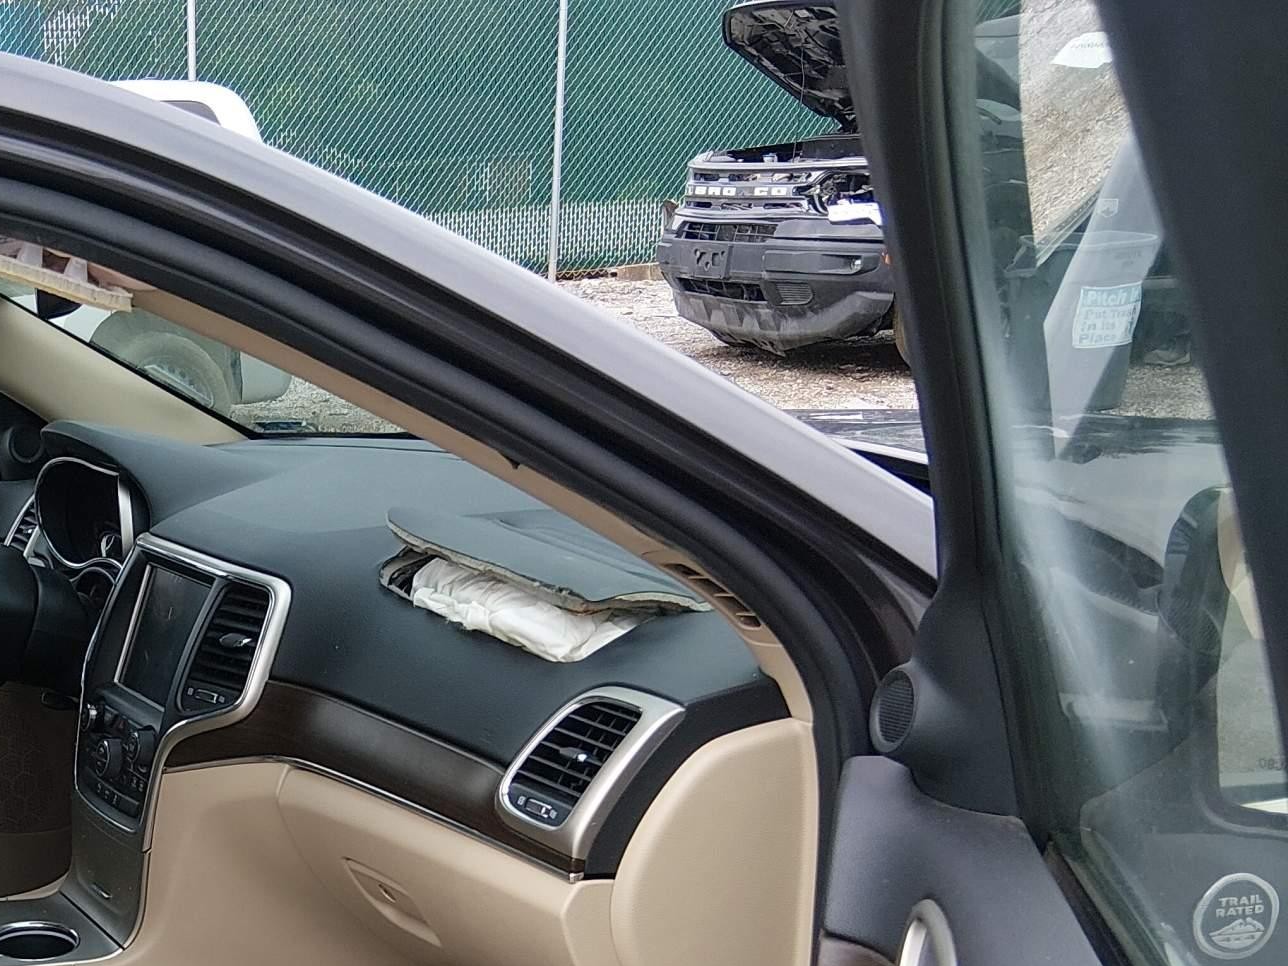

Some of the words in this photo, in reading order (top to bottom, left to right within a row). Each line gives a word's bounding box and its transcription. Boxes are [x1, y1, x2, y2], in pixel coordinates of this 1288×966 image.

[694, 186, 788, 196] BROCO
[1086, 289, 1128, 306] Pitch
[1085, 308, 1107, 320] Put
[1218, 894, 1263, 908] TRAIL
[1215, 904, 1265, 918] RATED
